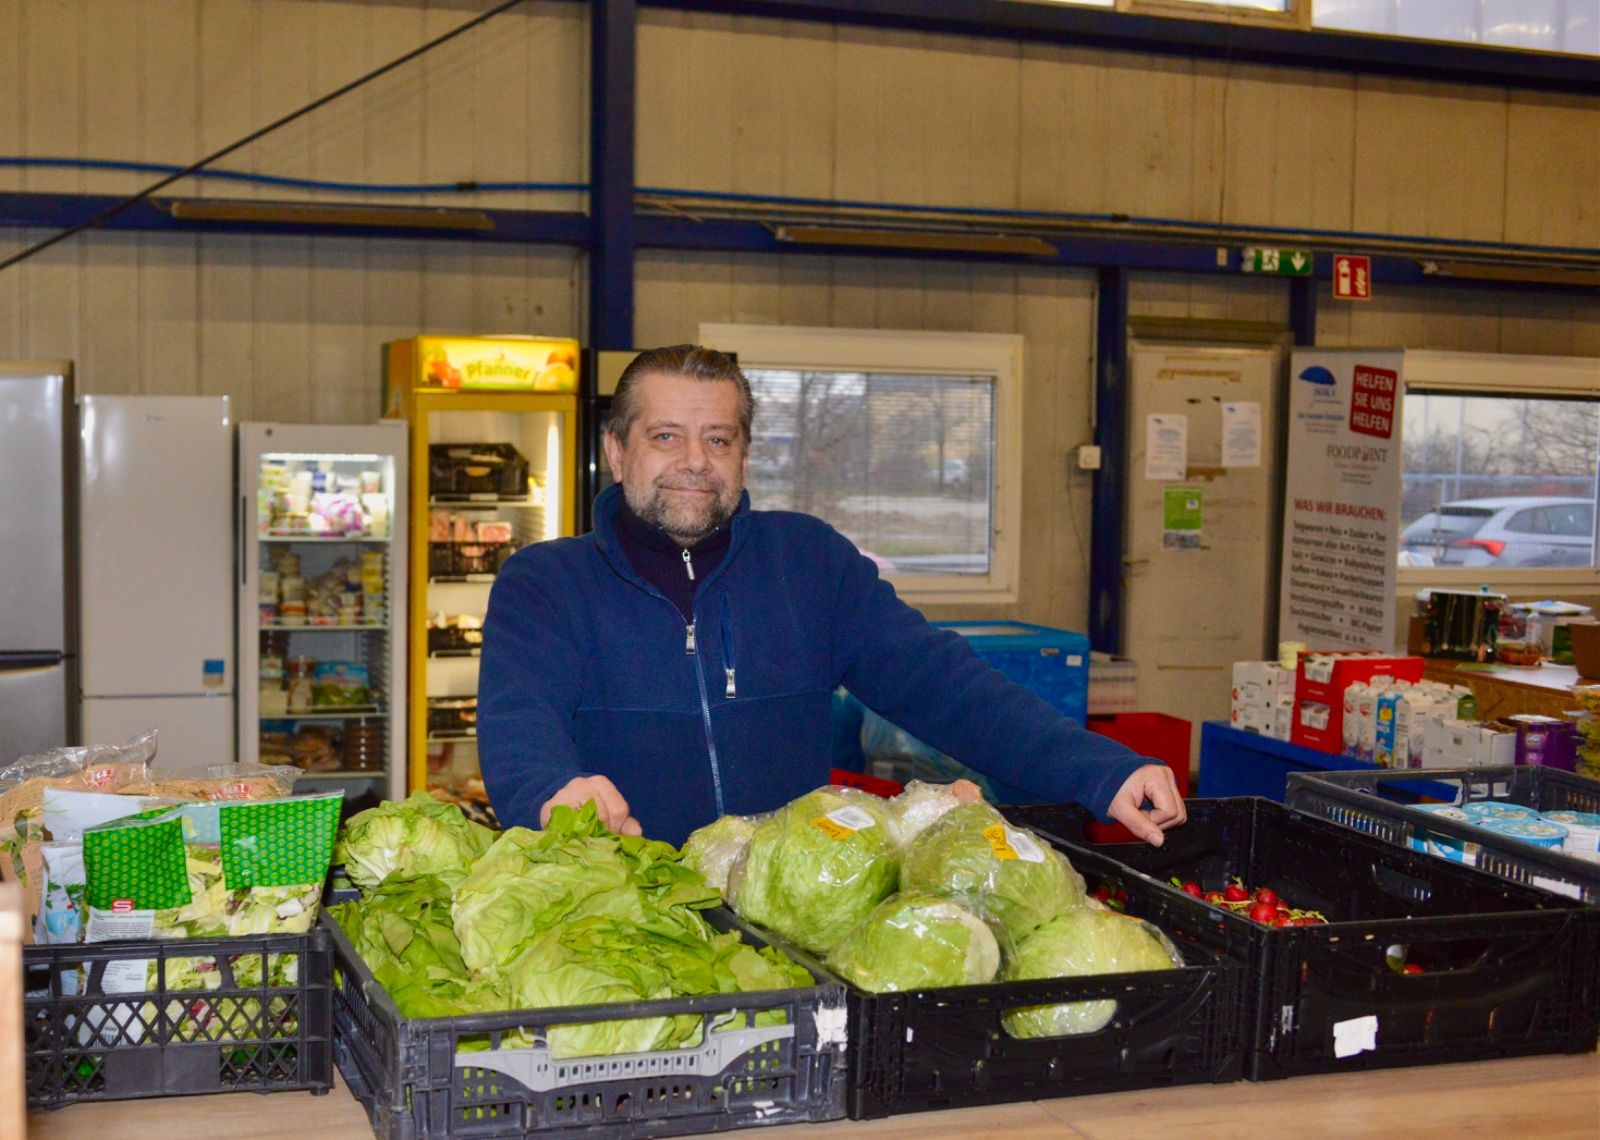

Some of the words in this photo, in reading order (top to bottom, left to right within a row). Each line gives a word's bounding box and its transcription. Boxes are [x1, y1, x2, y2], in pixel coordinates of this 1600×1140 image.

[465, 360, 530, 380] pfanner
[1357, 373, 1393, 391] HELFEN
[1355, 392, 1369, 407] SIE
[1371, 395, 1392, 411] UNS
[1353, 413, 1389, 432] HELFEN
[1294, 499, 1314, 512] WAS
[1316, 501, 1333, 513] WIR
[1335, 504, 1387, 520] BRAUCHEN:
